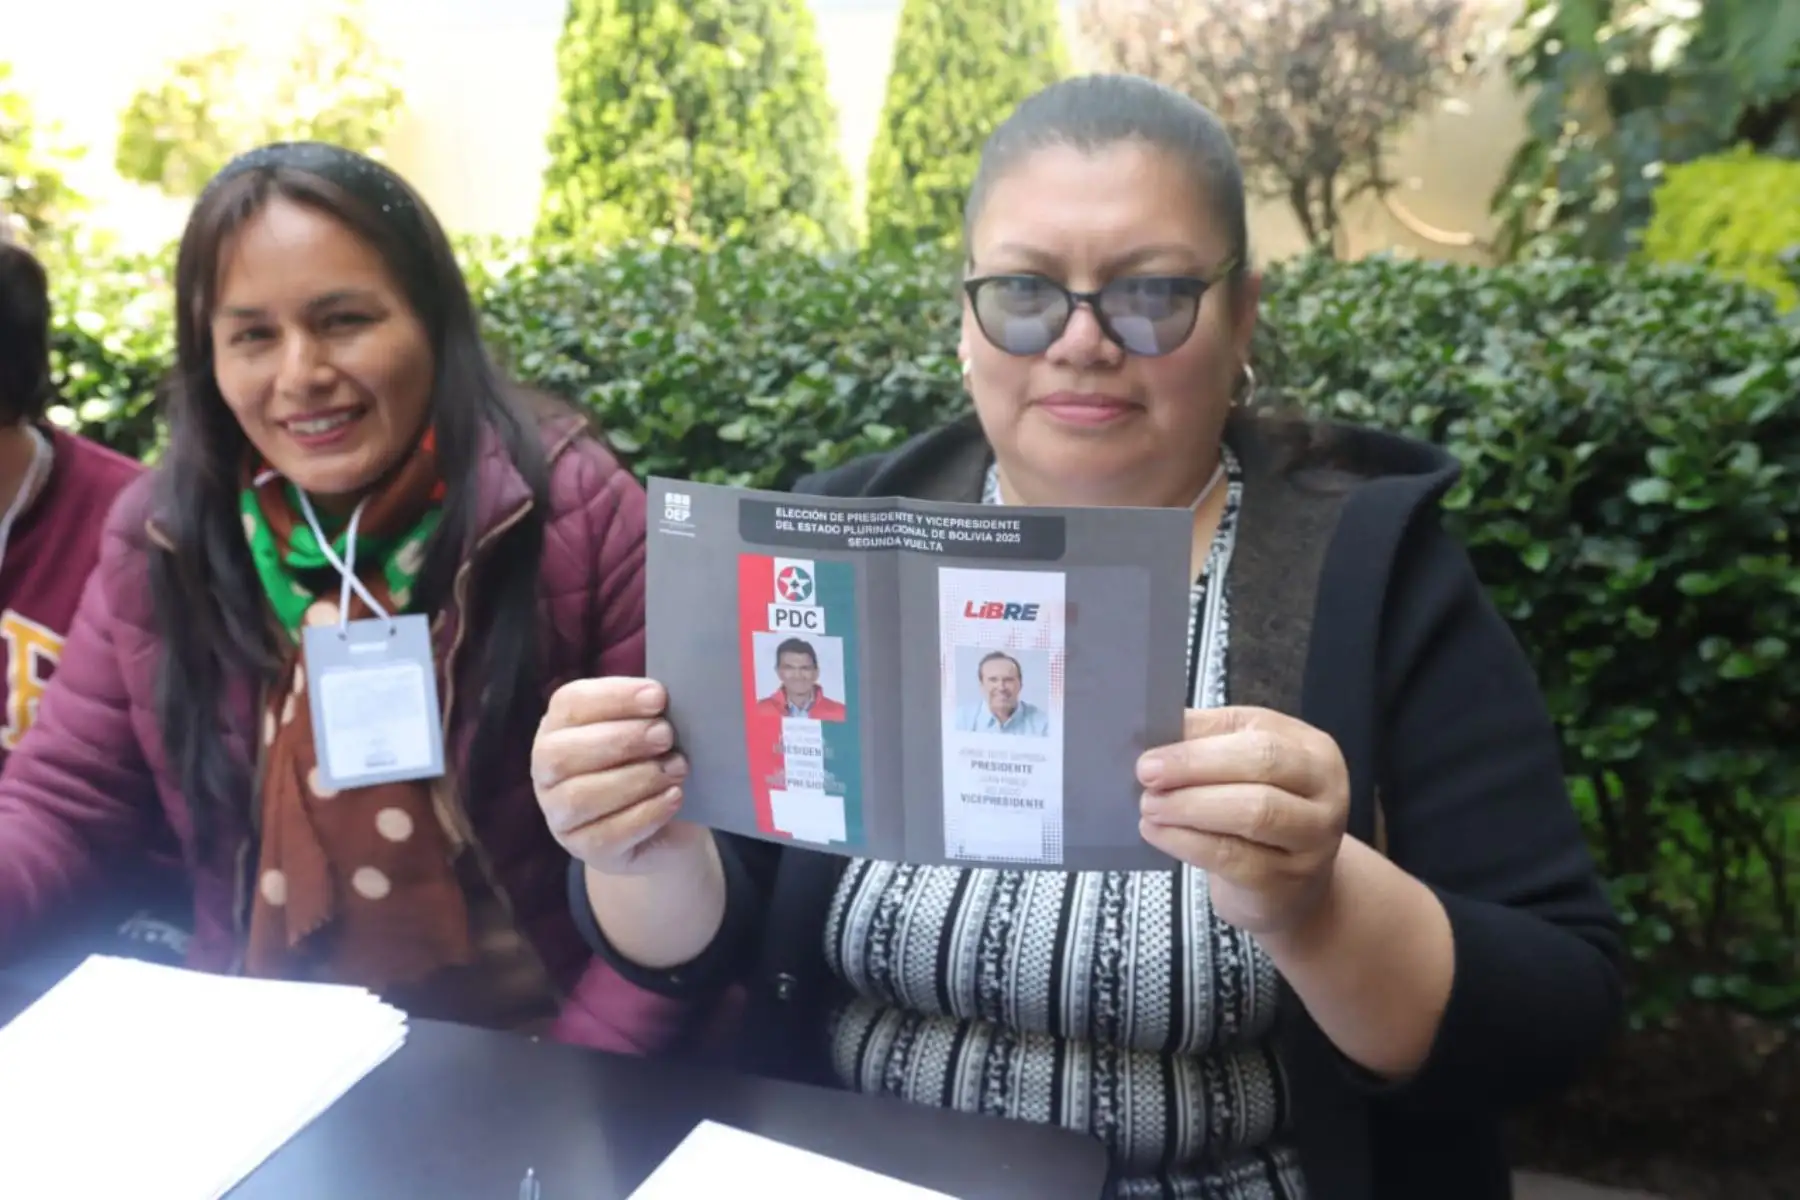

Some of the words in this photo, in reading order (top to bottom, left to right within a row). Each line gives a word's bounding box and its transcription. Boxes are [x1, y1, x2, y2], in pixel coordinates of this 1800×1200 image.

[665, 508, 691, 521] OEP
[775, 507, 827, 521] ELECCIÓN
[829, 512, 845, 522] DE
[847, 511, 914, 523] PRESIDENTE
[916, 515, 923, 524] Y
[925, 517, 1021, 530] VICEPRESIDENTE
[775, 520, 795, 531] DEL
[797, 522, 840, 534] ESTADO
[843, 523, 929, 538] PLURINACIONAL
[931, 529, 945, 539] DE
[948, 530, 993, 541] BOLIVIA
[995, 533, 1021, 543] 2025
[847, 536, 901, 548] SEGUNDA
[902, 537, 944, 552] VUELTA
[775, 608, 818, 630] PDC
[970, 760, 1033, 774] PRESIDENTE
[960, 793, 1045, 809] VICEPRESIDENTE
